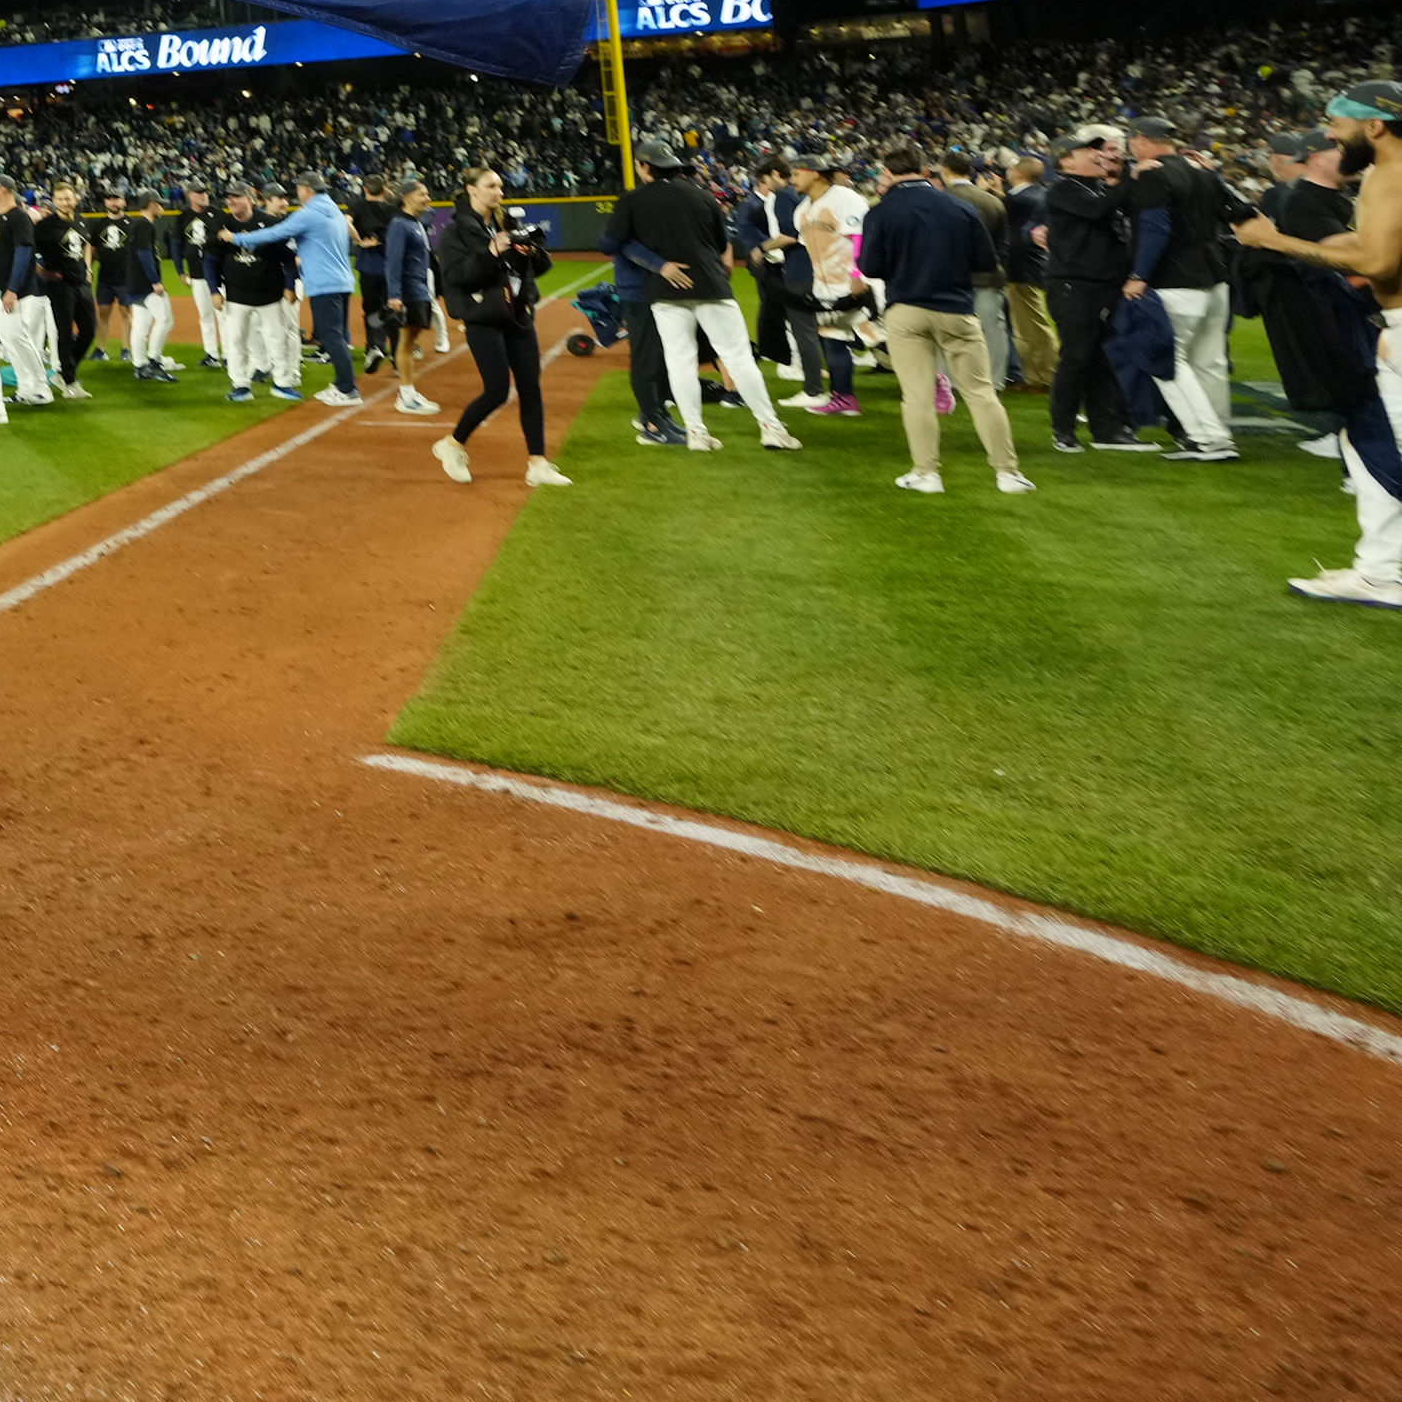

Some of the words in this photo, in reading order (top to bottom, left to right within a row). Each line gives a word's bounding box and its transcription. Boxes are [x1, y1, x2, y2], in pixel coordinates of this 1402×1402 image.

[635, 2, 712, 30] ALCS
[96, 49, 152, 74] ALCS
[156, 25, 268, 69] Bound
